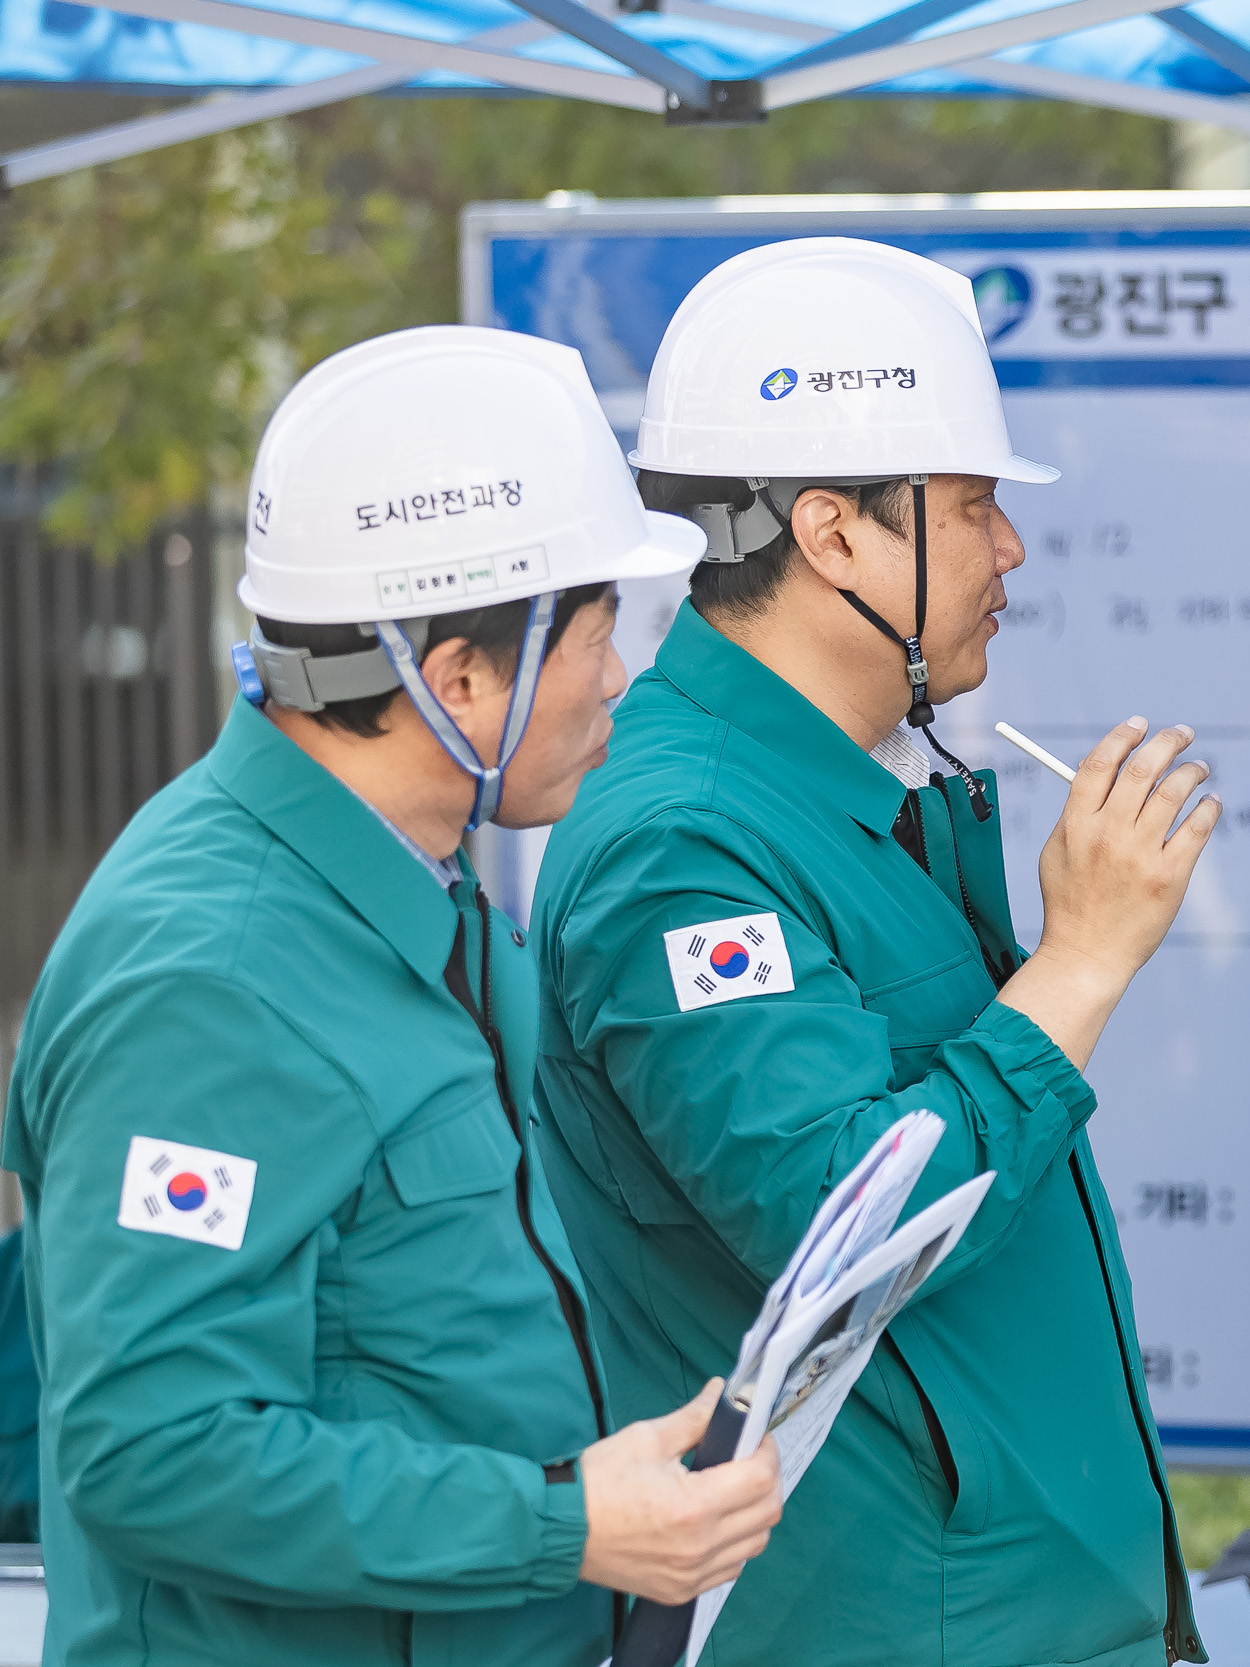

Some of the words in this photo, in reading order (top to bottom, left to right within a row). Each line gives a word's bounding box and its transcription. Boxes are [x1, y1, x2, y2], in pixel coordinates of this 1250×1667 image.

[1055, 268, 1230, 335] 광진구
[806, 367, 916, 393] 광진구청
[356, 480, 523, 531] 도시안전과장
[950, 762, 977, 797] SAFETY
